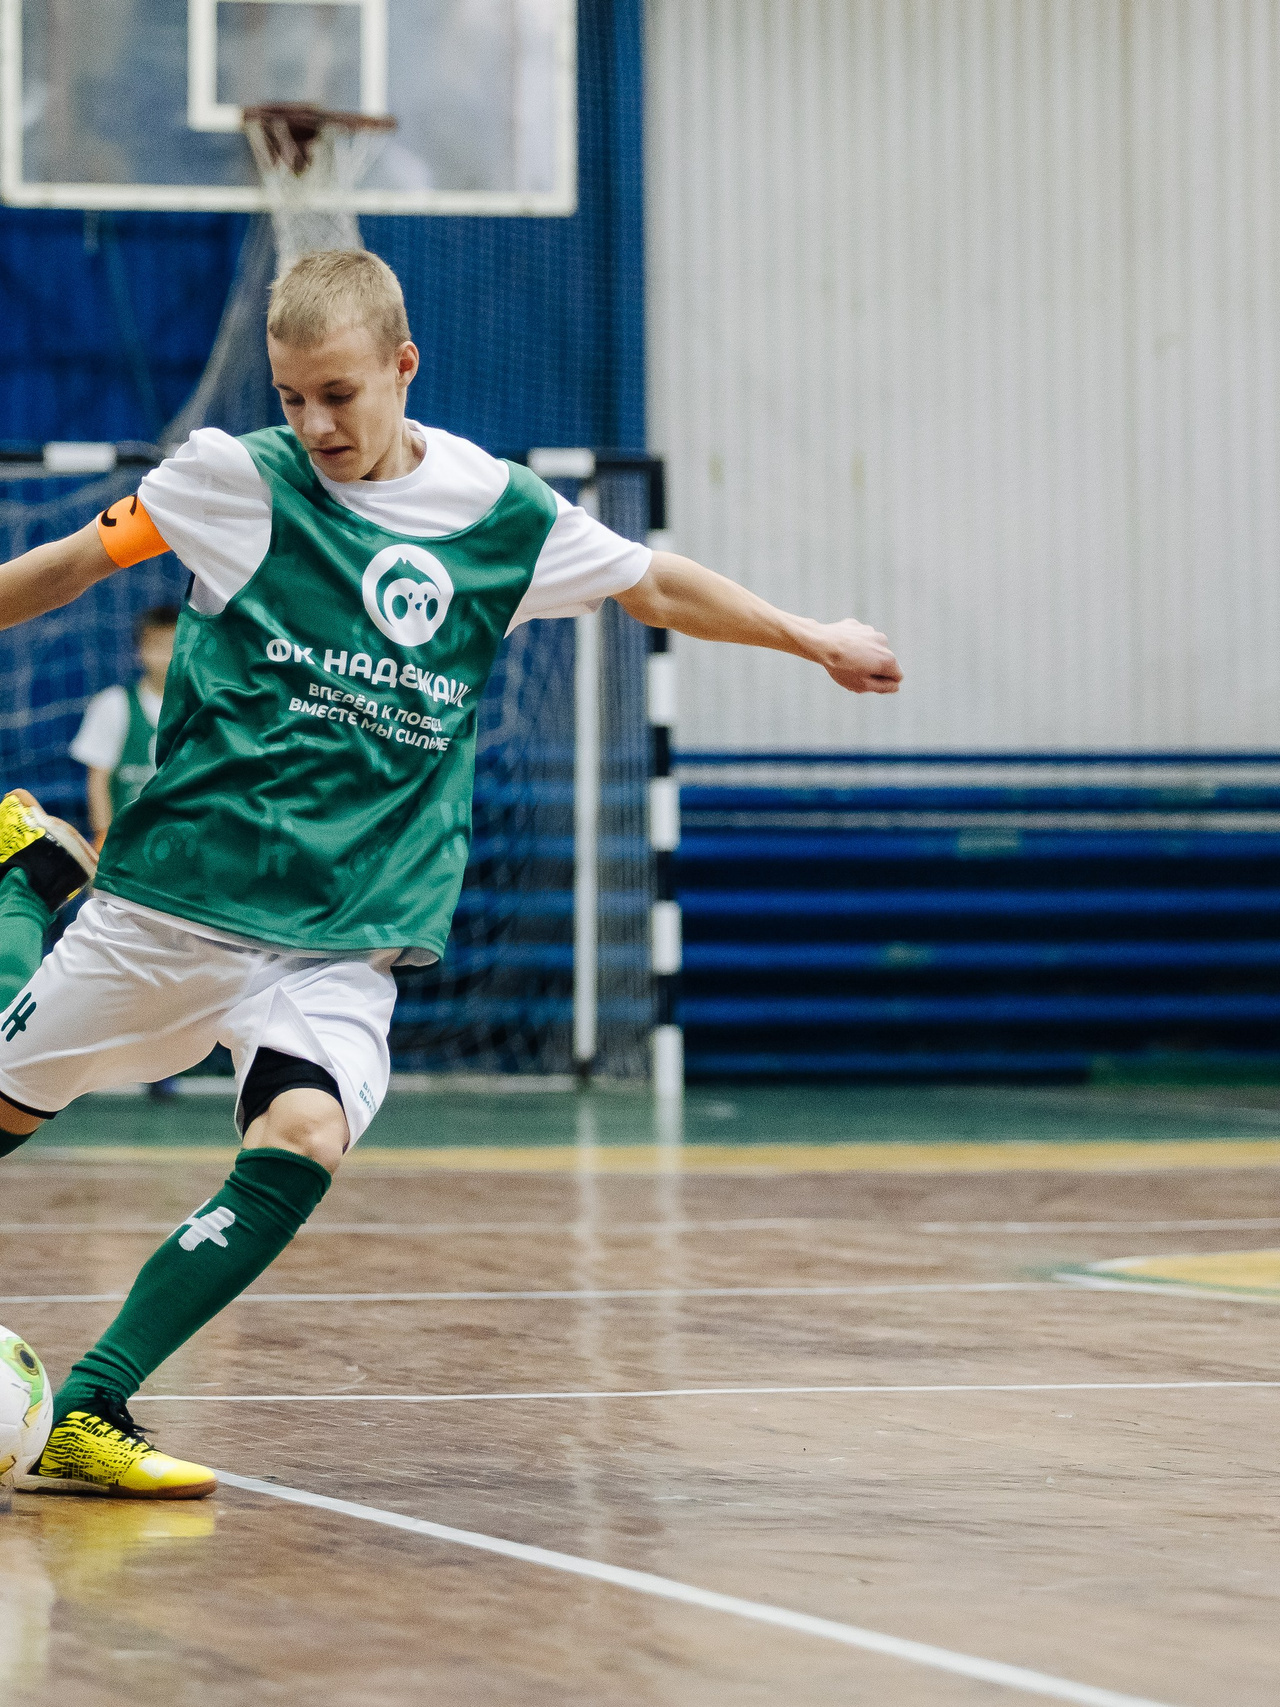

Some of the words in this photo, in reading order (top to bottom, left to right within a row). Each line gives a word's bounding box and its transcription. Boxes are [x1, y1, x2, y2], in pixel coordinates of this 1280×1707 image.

[266, 638, 316, 666] ФК
[288, 697, 358, 726] ВМЕСТЕ
[360, 717, 394, 740] МЫ
[308, 682, 378, 719] ВПЕРЁД
[381, 704, 394, 720] К
